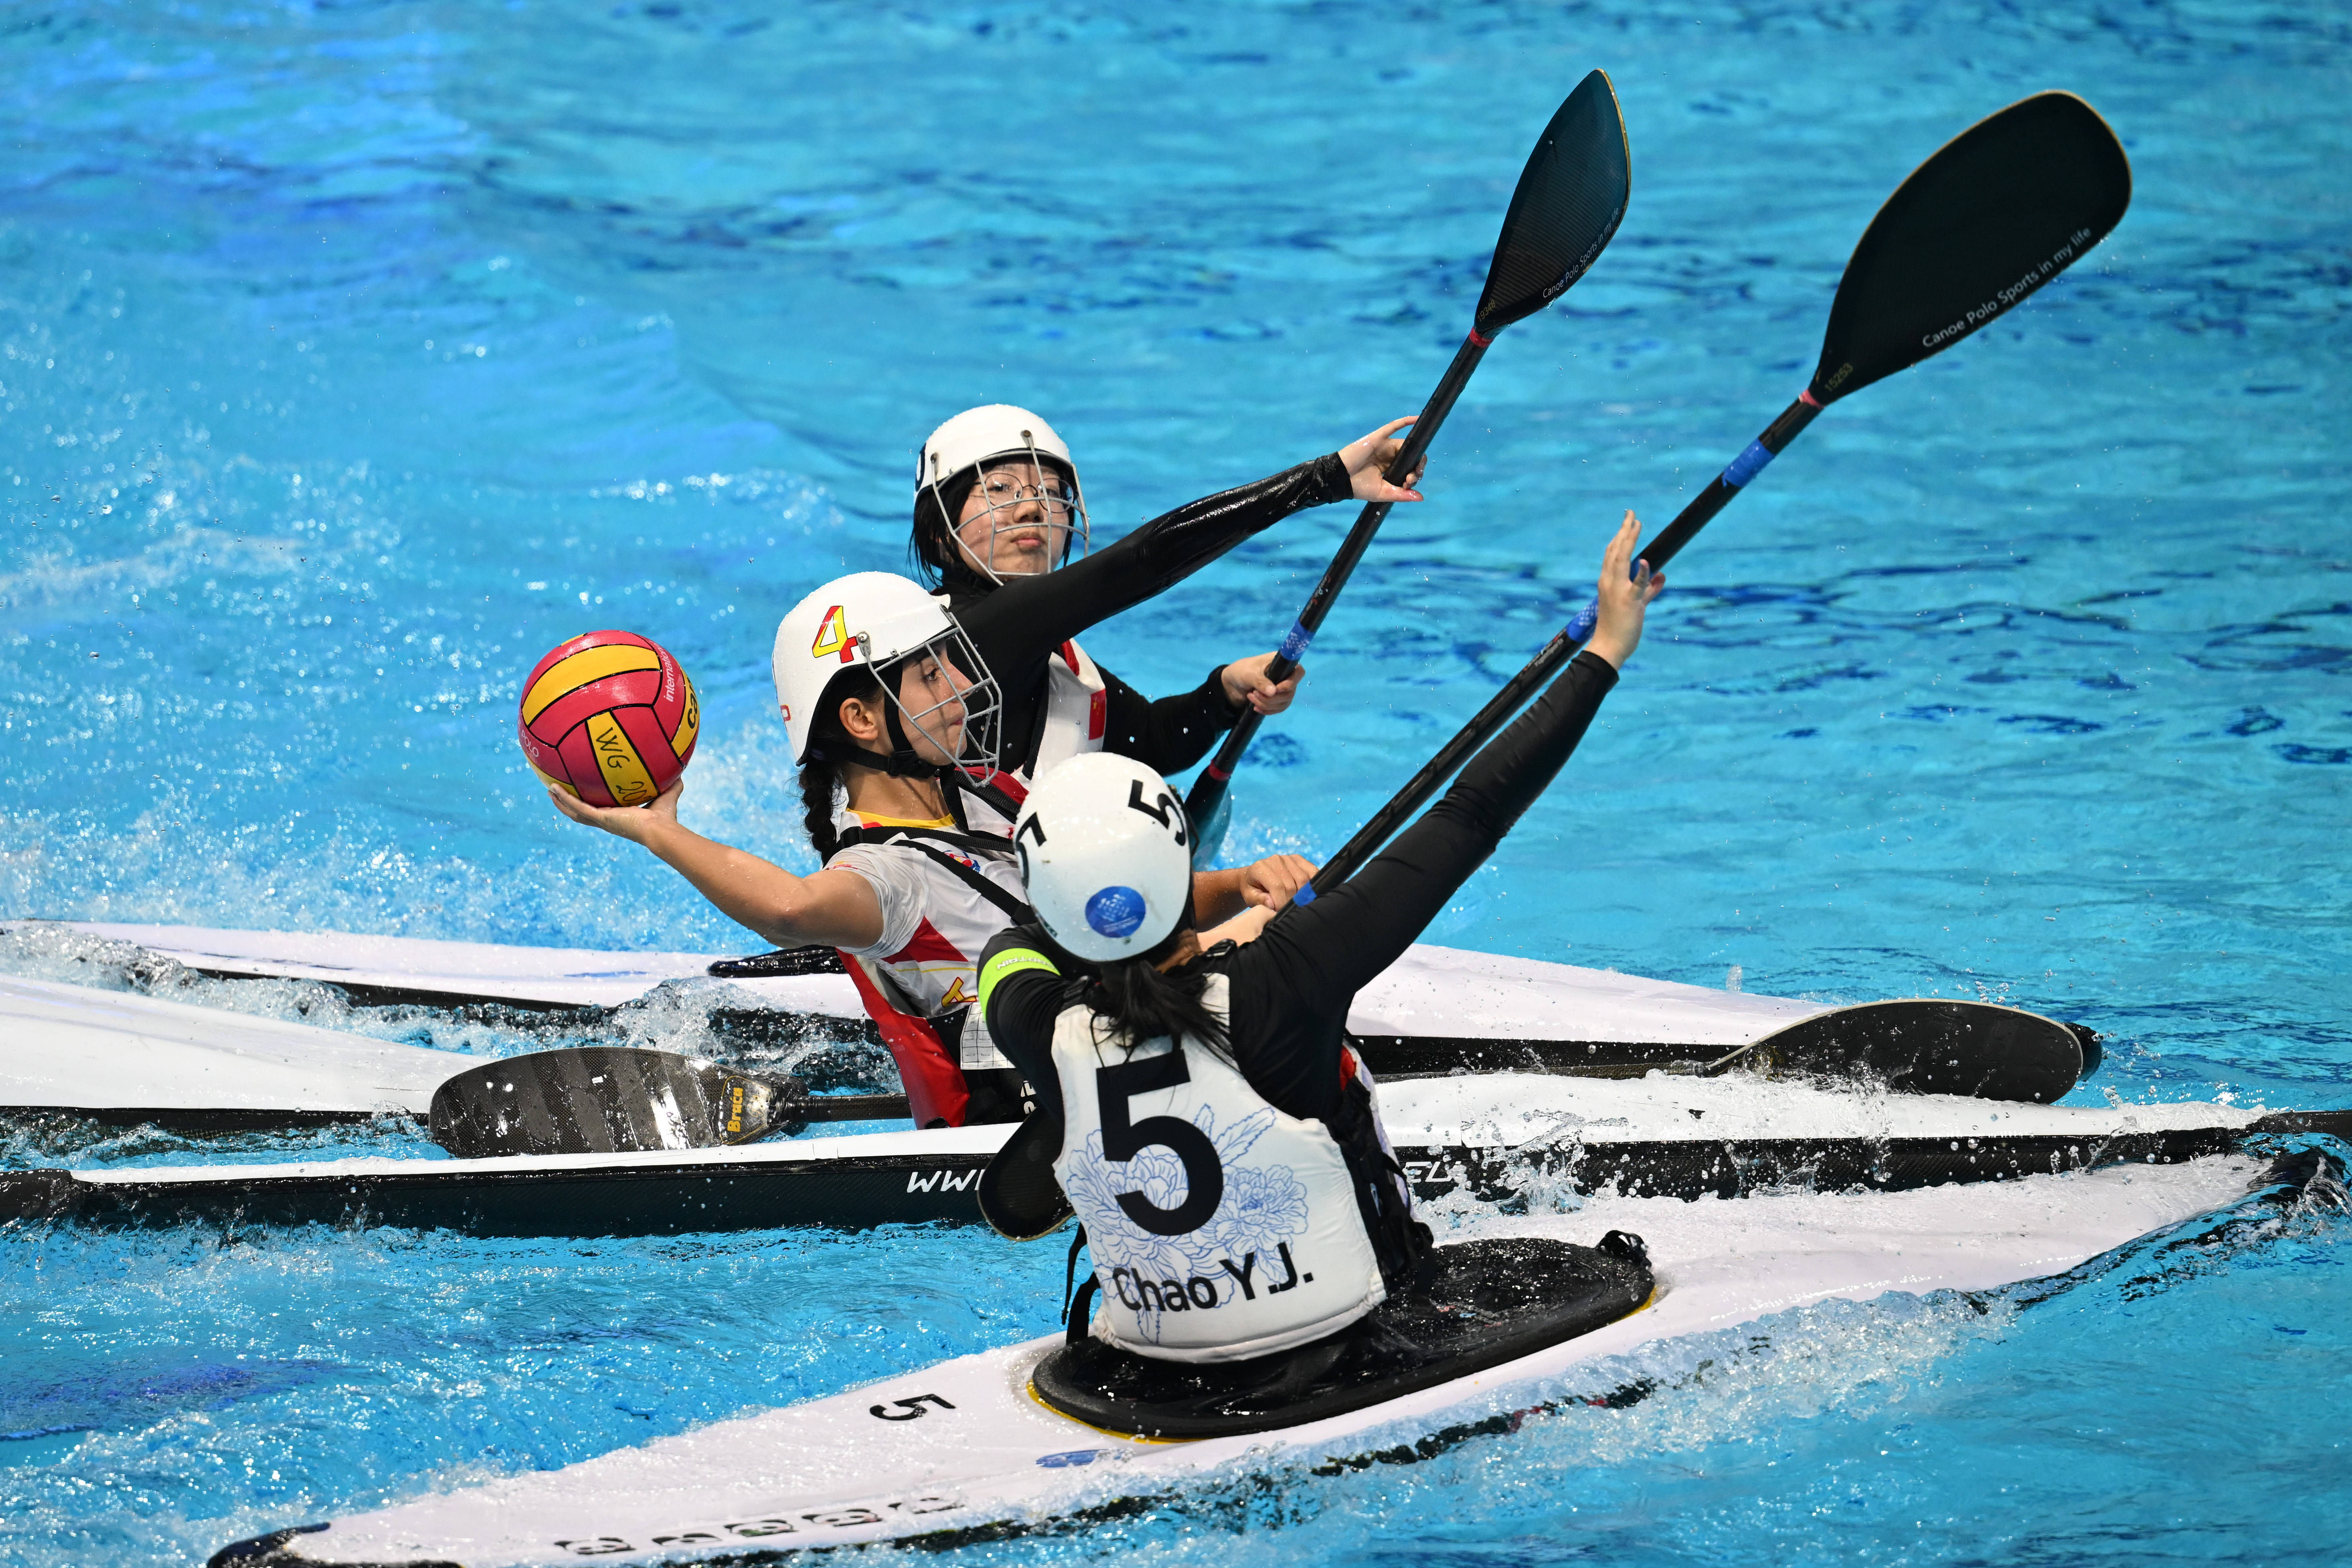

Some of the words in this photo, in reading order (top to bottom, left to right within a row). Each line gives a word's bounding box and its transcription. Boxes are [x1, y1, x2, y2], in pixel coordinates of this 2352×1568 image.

[1543, 280, 1564, 298] Canoe
[1565, 265, 1579, 283] Polo
[1580, 241, 1597, 267] Sports
[1598, 233, 1603, 244] in
[1604, 223, 1612, 237] my
[1923, 320, 1965, 347] Canoe
[1966, 300, 1998, 324] Polo
[1997, 270, 2040, 304] Sports
[2037, 263, 2054, 275] in
[2053, 244, 2073, 264] my
[2071, 227, 2091, 247] life
[1478, 299, 1496, 322] 19348
[812, 605, 858, 664] 4
[522, 730, 539, 757] POLO
[1128, 779, 1186, 846] 5
[1096, 1048, 1224, 1236] 5
[907, 1169, 986, 1193] WW
[1112, 1267, 1218, 1312] Chao
[1219, 1242, 1314, 1301] Y.J.
[869, 1393, 956, 1421] 5
